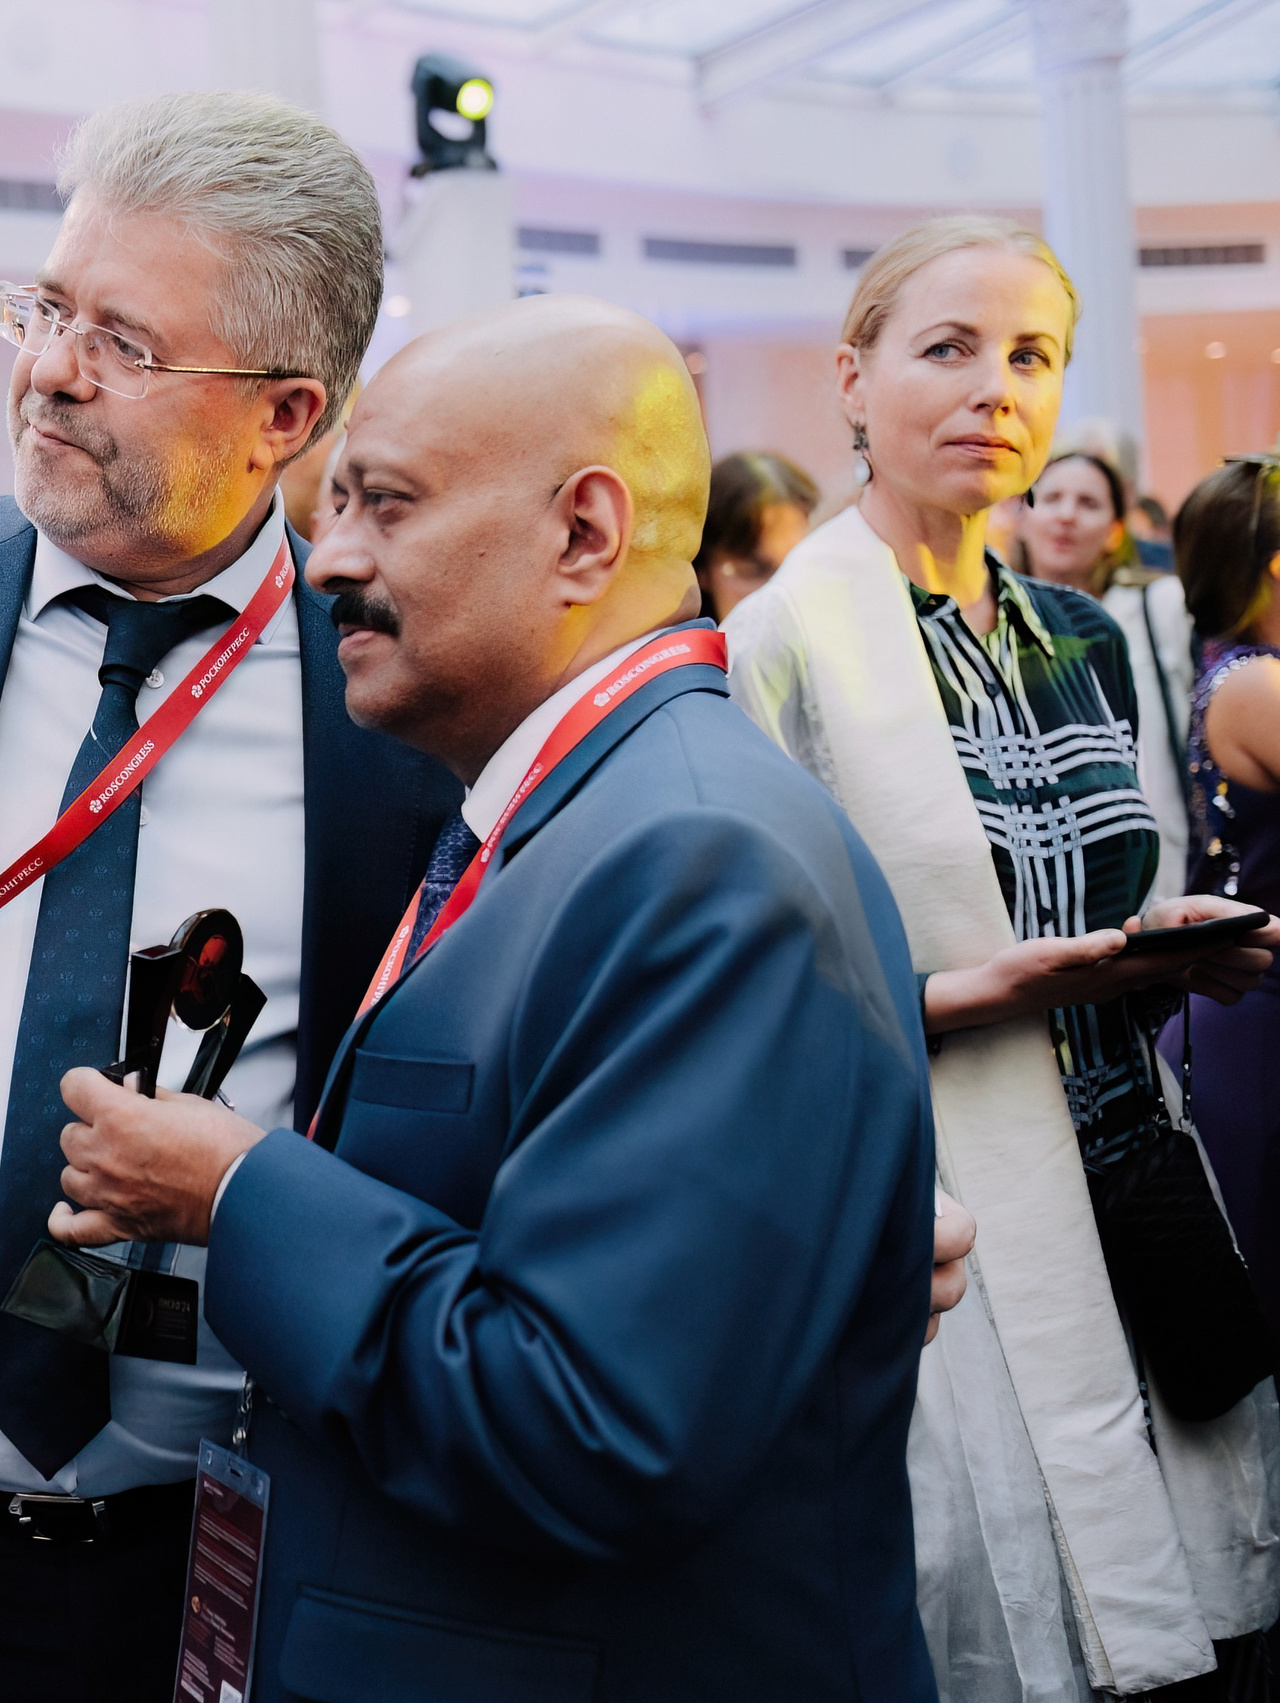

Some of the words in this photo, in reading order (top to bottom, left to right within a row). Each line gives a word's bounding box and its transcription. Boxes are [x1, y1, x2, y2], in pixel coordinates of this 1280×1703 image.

[199, 627, 250, 689] РОСКОНГРЕСС
[99, 740, 155, 803] ROSCONGRESS
[370, 939, 403, 1006] РОСКОНГРЕ
